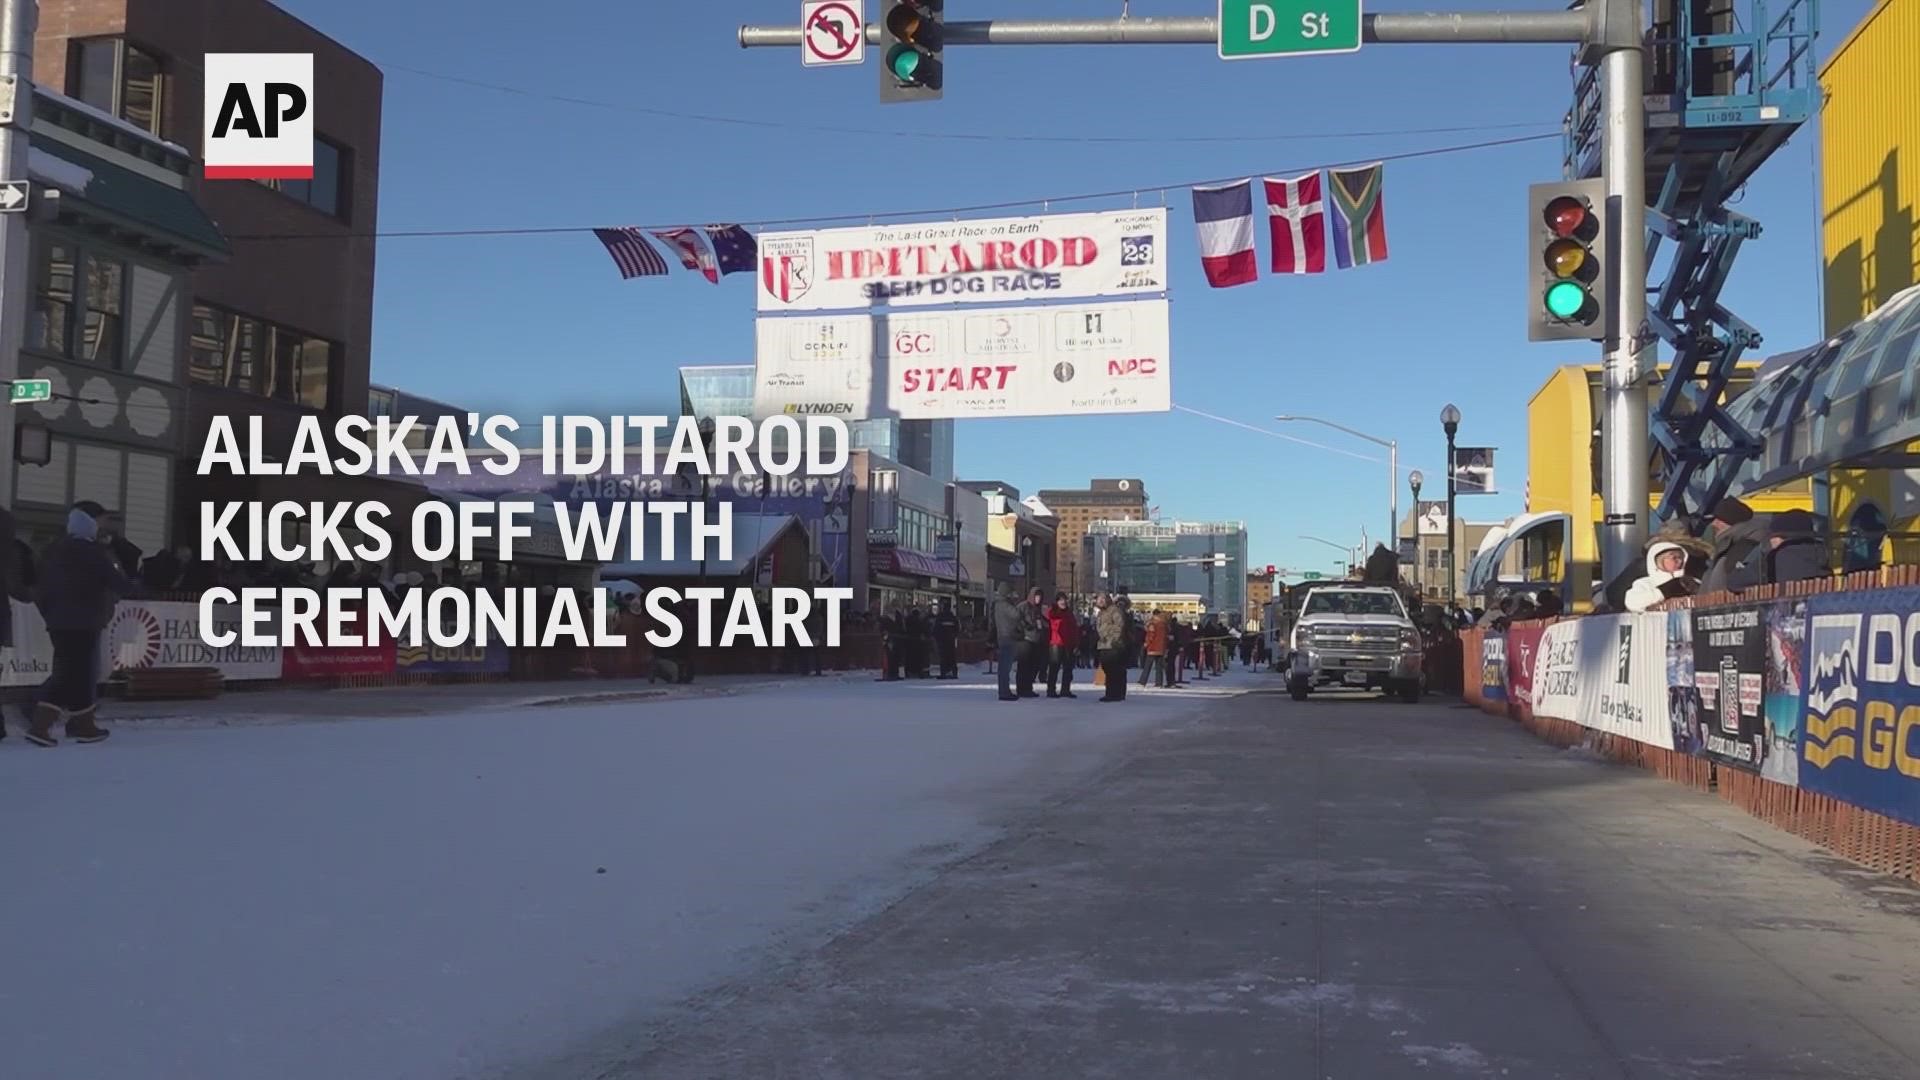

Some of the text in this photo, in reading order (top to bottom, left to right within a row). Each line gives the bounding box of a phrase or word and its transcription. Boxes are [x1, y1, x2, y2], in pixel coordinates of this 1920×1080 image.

[1249, 4, 1329, 41] D St
[874, 231, 894, 242] The
[898, 230, 921, 240] Last
[958, 225, 986, 237] Race
[990, 225, 1005, 235] on
[825, 236, 1099, 280] IDITAROD
[1124, 243, 1153, 262] 23
[931, 276, 985, 296] DOG
[992, 271, 1062, 292] RACE
[903, 365, 1017, 393] START
[18, 385, 26, 396] D
[797, 403, 854, 414] LYNDEN
[569, 473, 662, 498] Alaska
[732, 470, 841, 502] Gallery
[162, 643, 275, 664] MIDSTREAM
[432, 644, 485, 662] GOLD
[9, 658, 49, 673] Alaska
